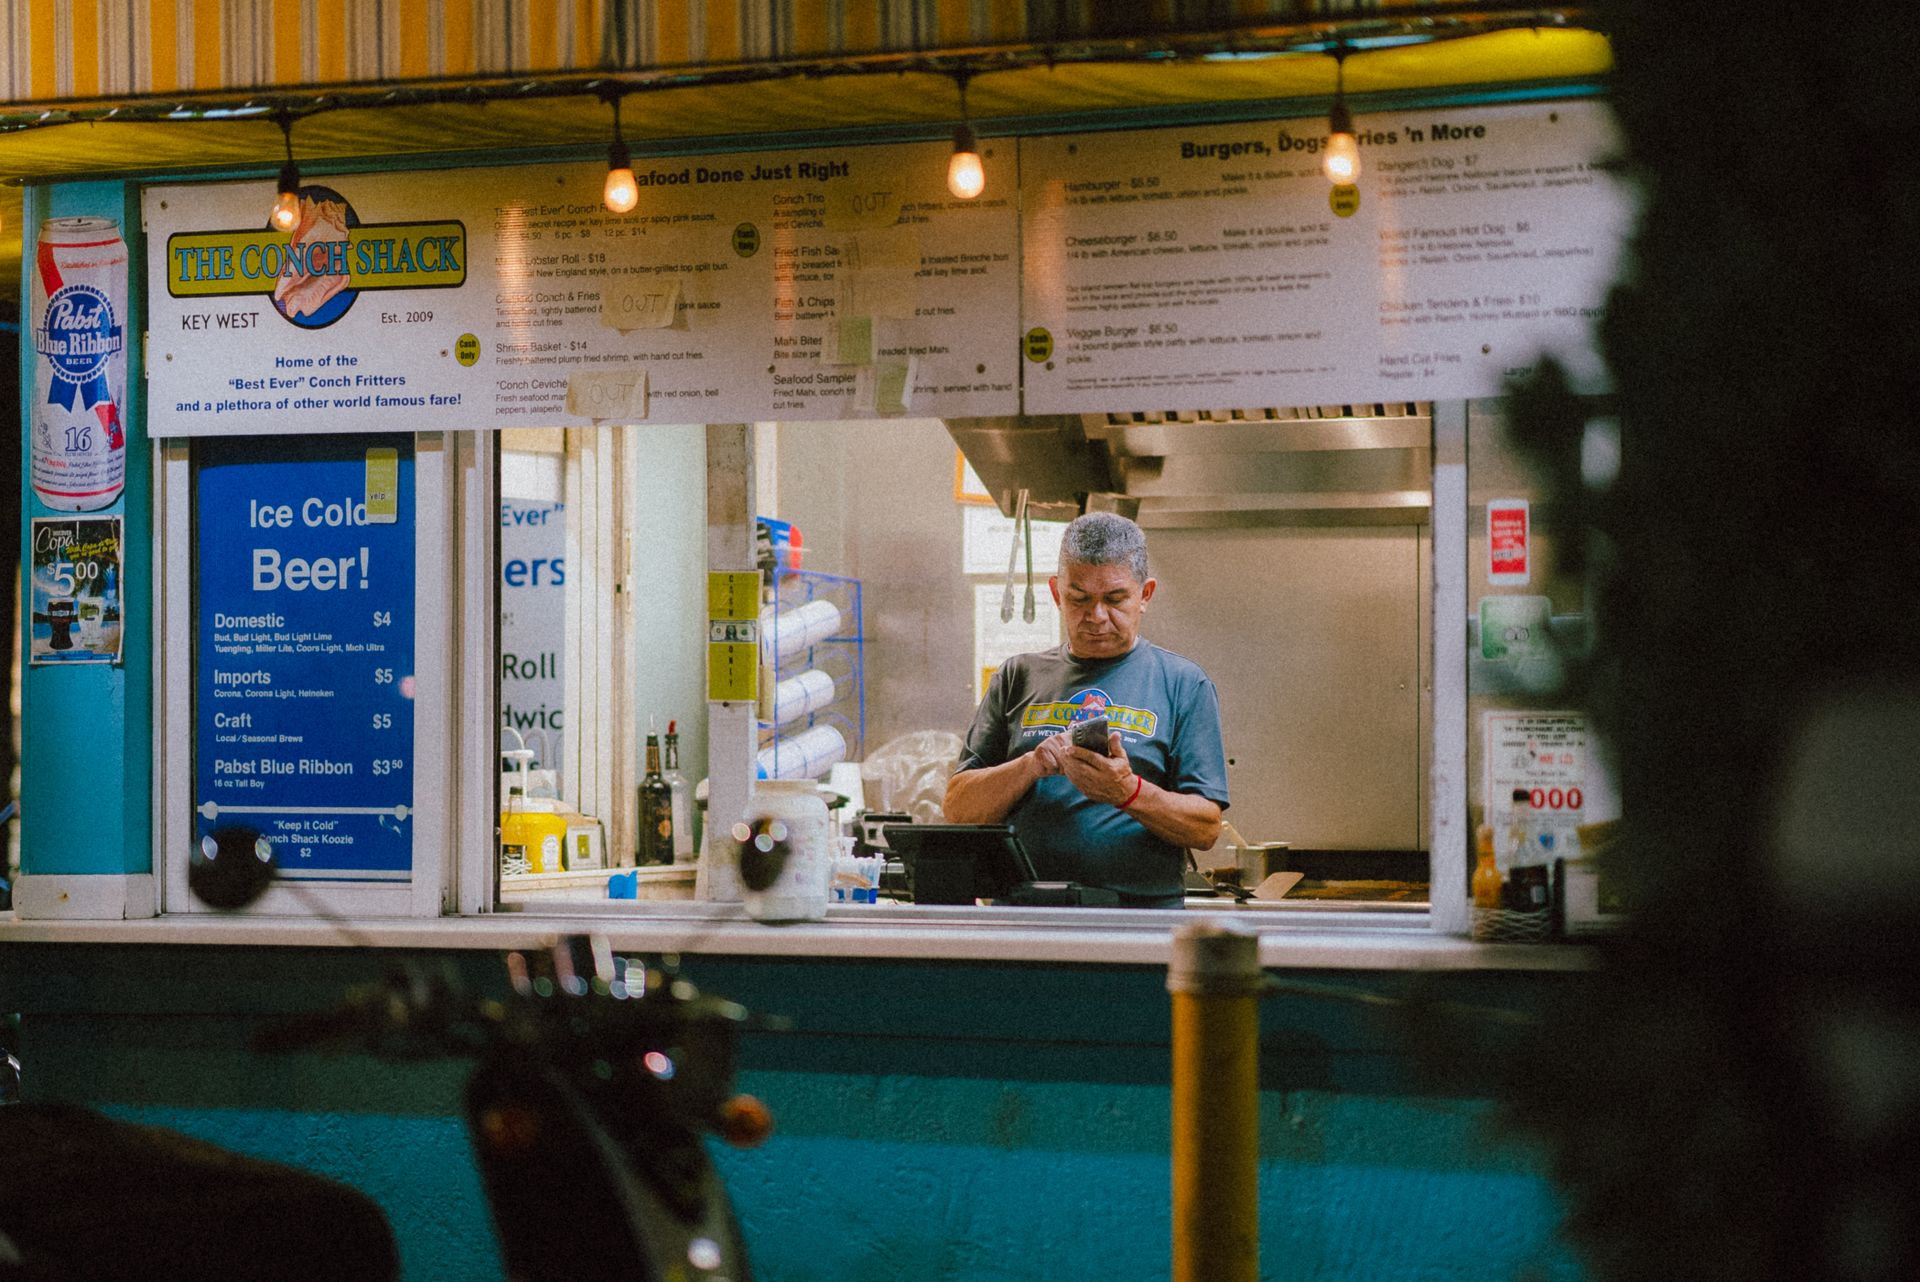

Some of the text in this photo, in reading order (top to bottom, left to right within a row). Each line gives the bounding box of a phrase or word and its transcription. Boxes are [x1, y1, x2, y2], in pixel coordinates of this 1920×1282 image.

[1180, 140, 1272, 159] Burgers,
[1355, 128, 1398, 145] ries
[1431, 123, 1487, 140] More
[635, 161, 850, 187] afood Done Just Right
[853, 191, 892, 214] OUT
[562, 254, 580, 264] Roll
[589, 253, 606, 263] $18
[802, 246, 822, 257] Fish
[175, 236, 461, 282] THE CONCH SHACK
[537, 270, 553, 278] New
[556, 268, 586, 279] England
[536, 292, 565, 303] Conch
[578, 291, 600, 301] Fries
[622, 293, 664, 313] OUT
[807, 296, 835, 308] Chips
[54, 299, 104, 330] Pabst
[541, 307, 563, 317] lightly
[565, 305, 596, 314] battered
[182, 310, 434, 330] KEY WEST Est. 2009
[36, 330, 68, 354] Blue
[69, 331, 121, 356] Ribbon
[460, 340, 476, 348] Cash
[531, 341, 561, 352] Basket
[570, 341, 587, 351] $14
[65, 357, 93, 365] BEER
[275, 354, 358, 369] Home of the
[558, 354, 582, 365] plump
[633, 353, 649, 361] with
[650, 352, 670, 360] hand
[309, 375, 351, 388] Conch
[355, 373, 406, 387] Fritters
[774, 374, 814, 385] Seafood
[496, 394, 518, 402] Fresh
[520, 393, 550, 402] seafood
[590, 382, 636, 405] OUT
[176, 393, 462, 414] and a plethora of other world famous fare!
[65, 427, 92, 451] 16
[370, 492, 385, 500] yelp
[250, 499, 294, 528] Ice
[252, 547, 370, 591] Beer!
[214, 611, 391, 629] Domestic $4
[214, 632, 332, 643] Bud, Bud Light, Bud Light Lime
[214, 643, 384, 655] Yuengling, Miller Lite, Coors Light, Mich Ultra
[503, 652, 555, 680] Roll
[214, 667, 393, 688] Imports $5
[214, 689, 334, 699] Corona, Corona Light, Heineken
[214, 712, 392, 729] Craft $5
[279, 734, 303, 743] Brews
[214, 759, 256, 775] Pabst
[260, 758, 295, 775] Blue
[298, 758, 354, 775] Ribbon
[214, 779, 223, 788] 16
[235, 778, 248, 788] Tall
[250, 778, 265, 790] Boy
[304, 820, 310, 830] it
[291, 833, 319, 844] Shack
[321, 833, 354, 844] Koozie
[300, 847, 311, 858] $2
